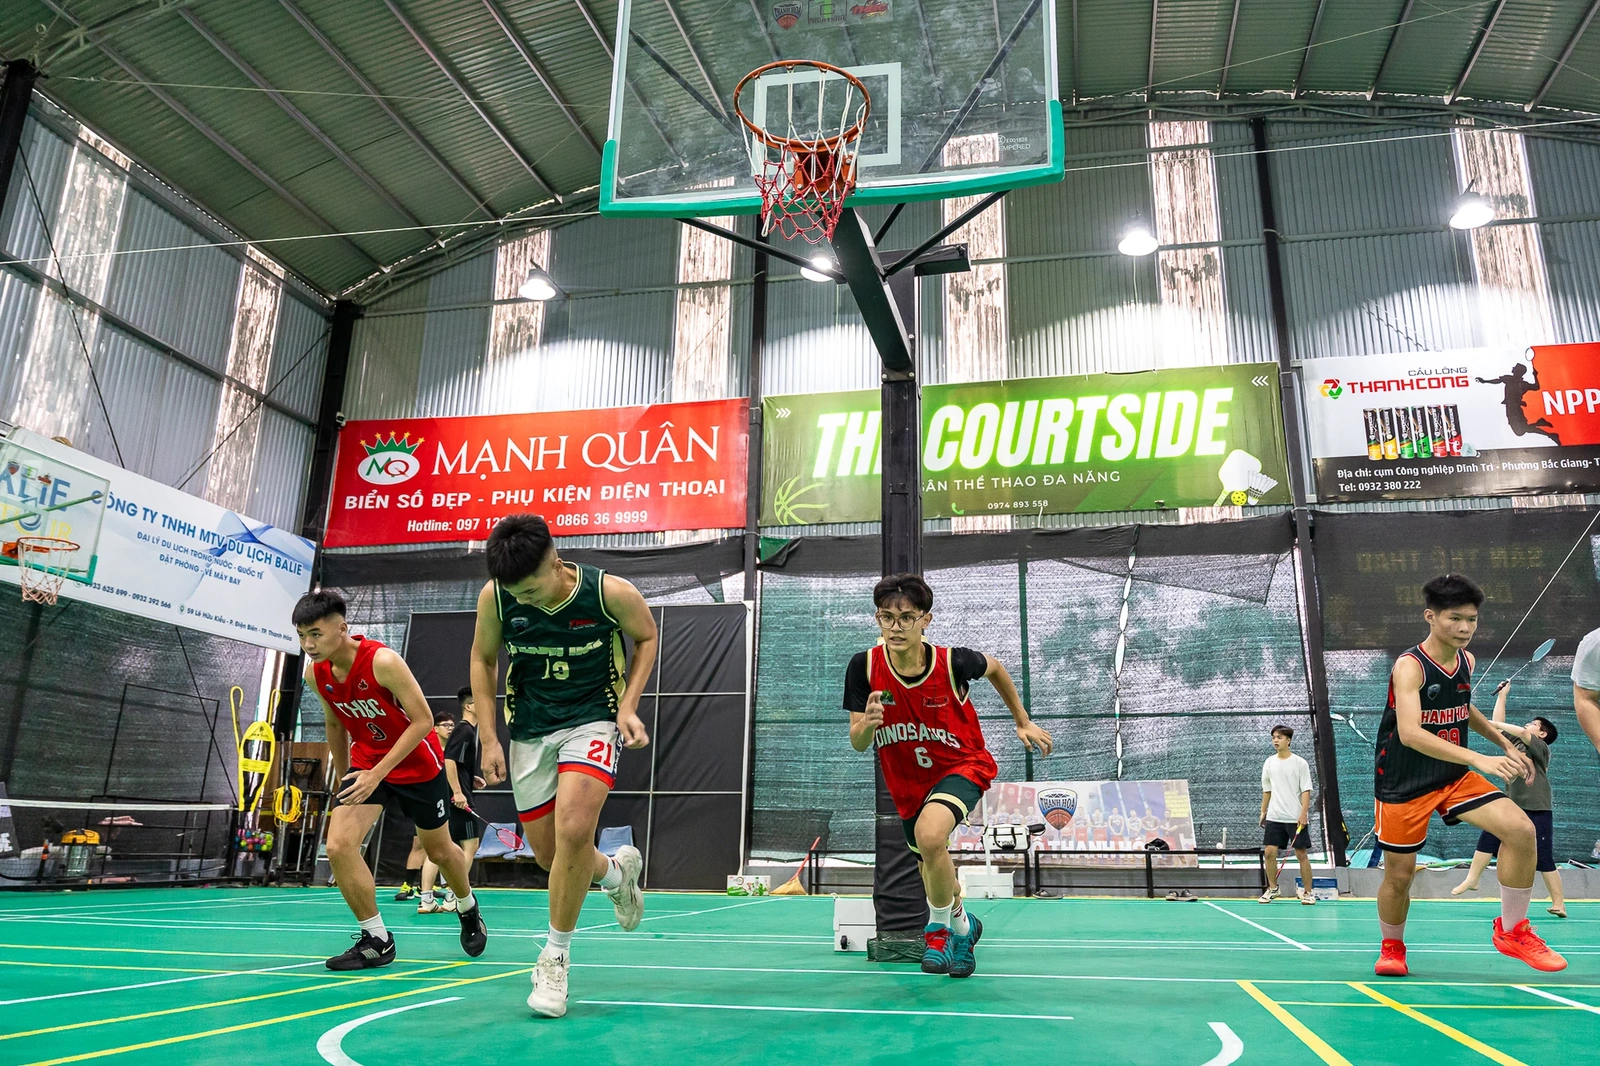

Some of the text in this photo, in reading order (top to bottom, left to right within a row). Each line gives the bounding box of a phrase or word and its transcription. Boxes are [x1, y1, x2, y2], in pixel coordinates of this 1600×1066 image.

[1542, 388, 1600, 416] NPP
[812, 387, 1234, 479] TH COURTSIDE
[432, 420, 720, 480] MẠNH QUÂN
[954, 475, 985, 490] THỂ
[992, 476, 1036, 488] THAO
[1043, 474, 1064, 486] ĐA
[1073, 470, 1120, 484] NĂNG
[1339, 480, 1421, 492] Tel: 0932 380 222
[345, 490, 390, 510] BIỂN
[396, 490, 424, 508] SỐ
[432, 492, 471, 510] ĐẸP
[492, 490, 534, 506] PHỤ
[542, 485, 591, 504] KIỆN
[601, 482, 650, 502] ĐIỆN
[659, 480, 724, 497] THOẠI
[407, 520, 452, 532] Hotline:
[456, 518, 480, 531] 097
[556, 514, 588, 526] 0866
[594, 512, 610, 525] 36
[615, 510, 648, 523] 9999
[142, 507, 158, 524] TY
[162, 514, 196, 538] TNHH
[200, 528, 226, 549] MTV
[227, 539, 244, 555] DU
[246, 546, 272, 564] LỊCH
[275, 558, 303, 576] BALIE
[1421, 708, 1455, 725] HANH
[876, 722, 961, 749] DINOSAURS
[587, 740, 612, 767] 21
[914, 746, 933, 768] 6
[437, 798, 446, 818] 3
